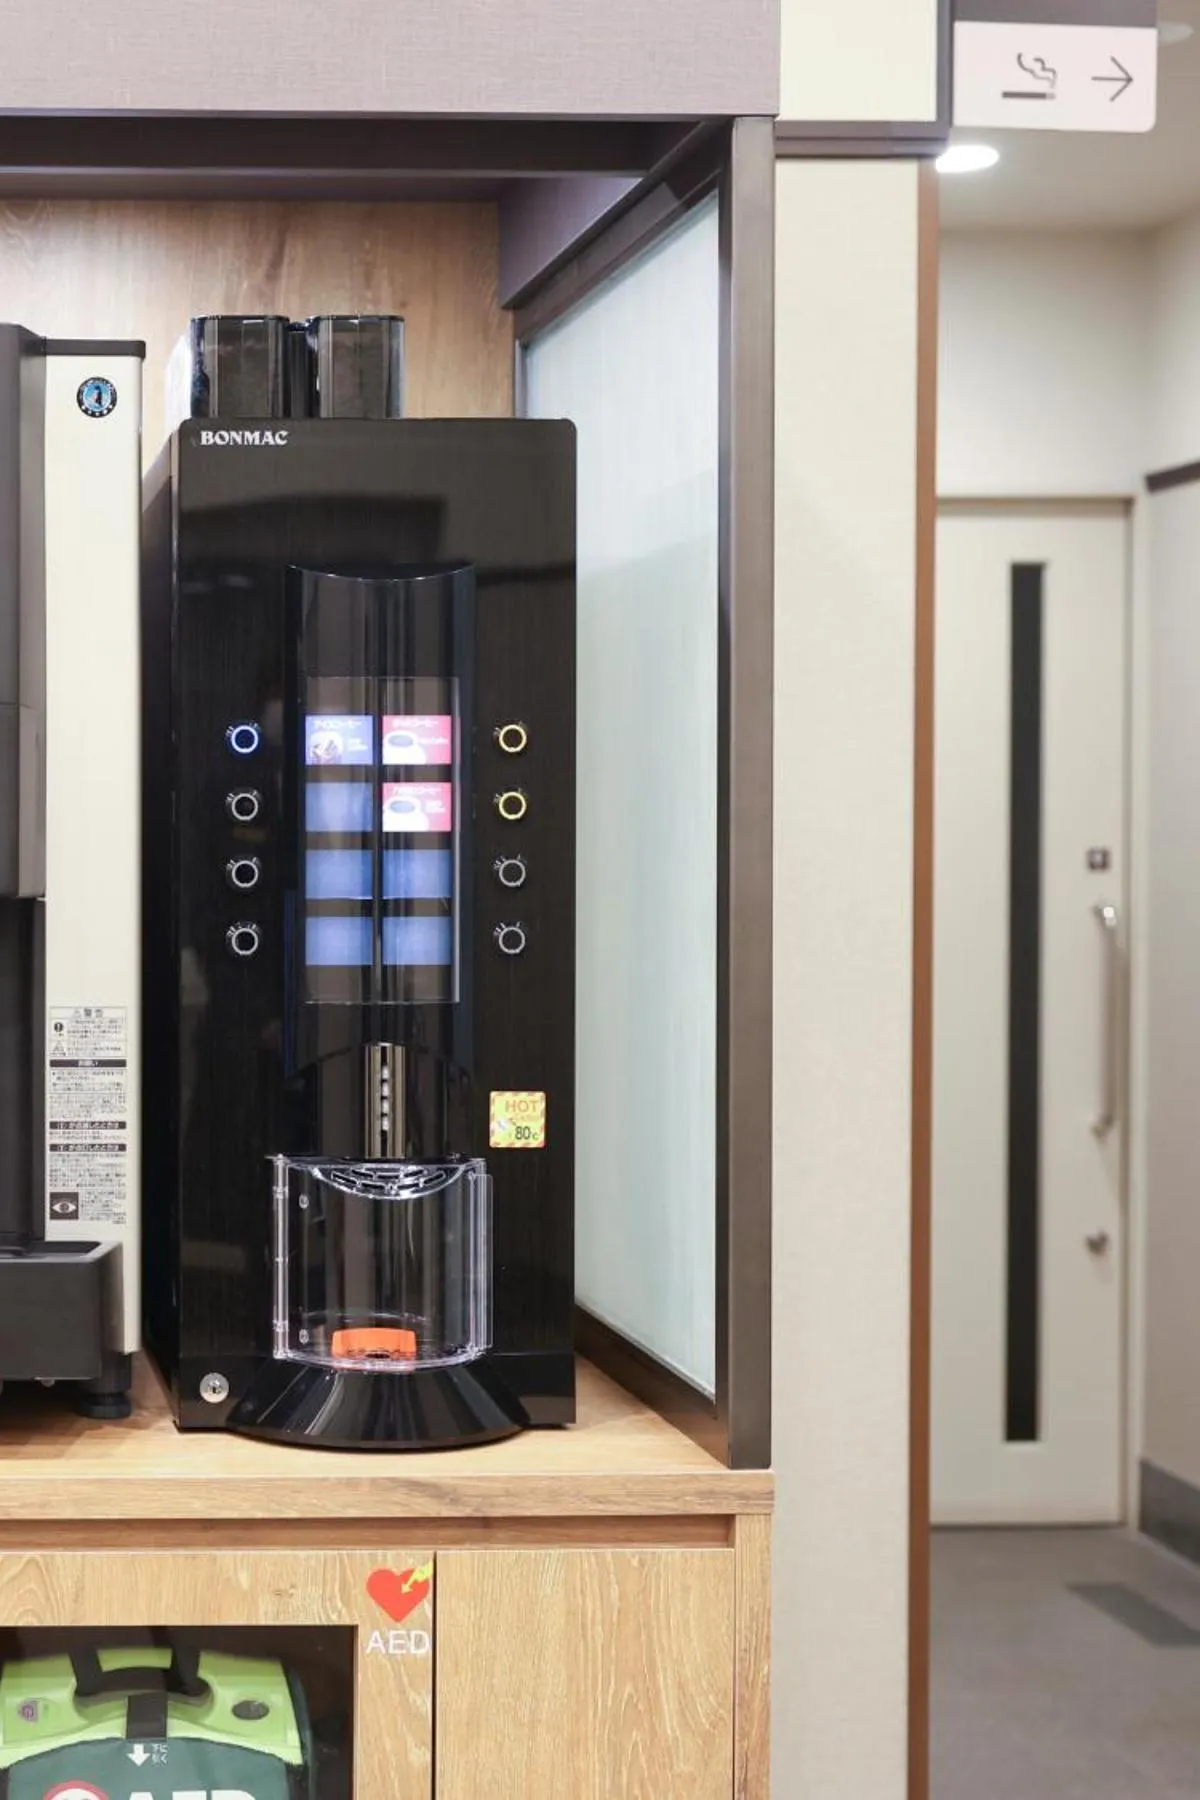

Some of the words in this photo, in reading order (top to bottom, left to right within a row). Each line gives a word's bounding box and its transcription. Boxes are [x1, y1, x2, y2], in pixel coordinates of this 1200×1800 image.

[200, 430, 288, 446] BONMAC
[505, 1099, 539, 1113] HOT
[365, 1630, 430, 1654] AED
